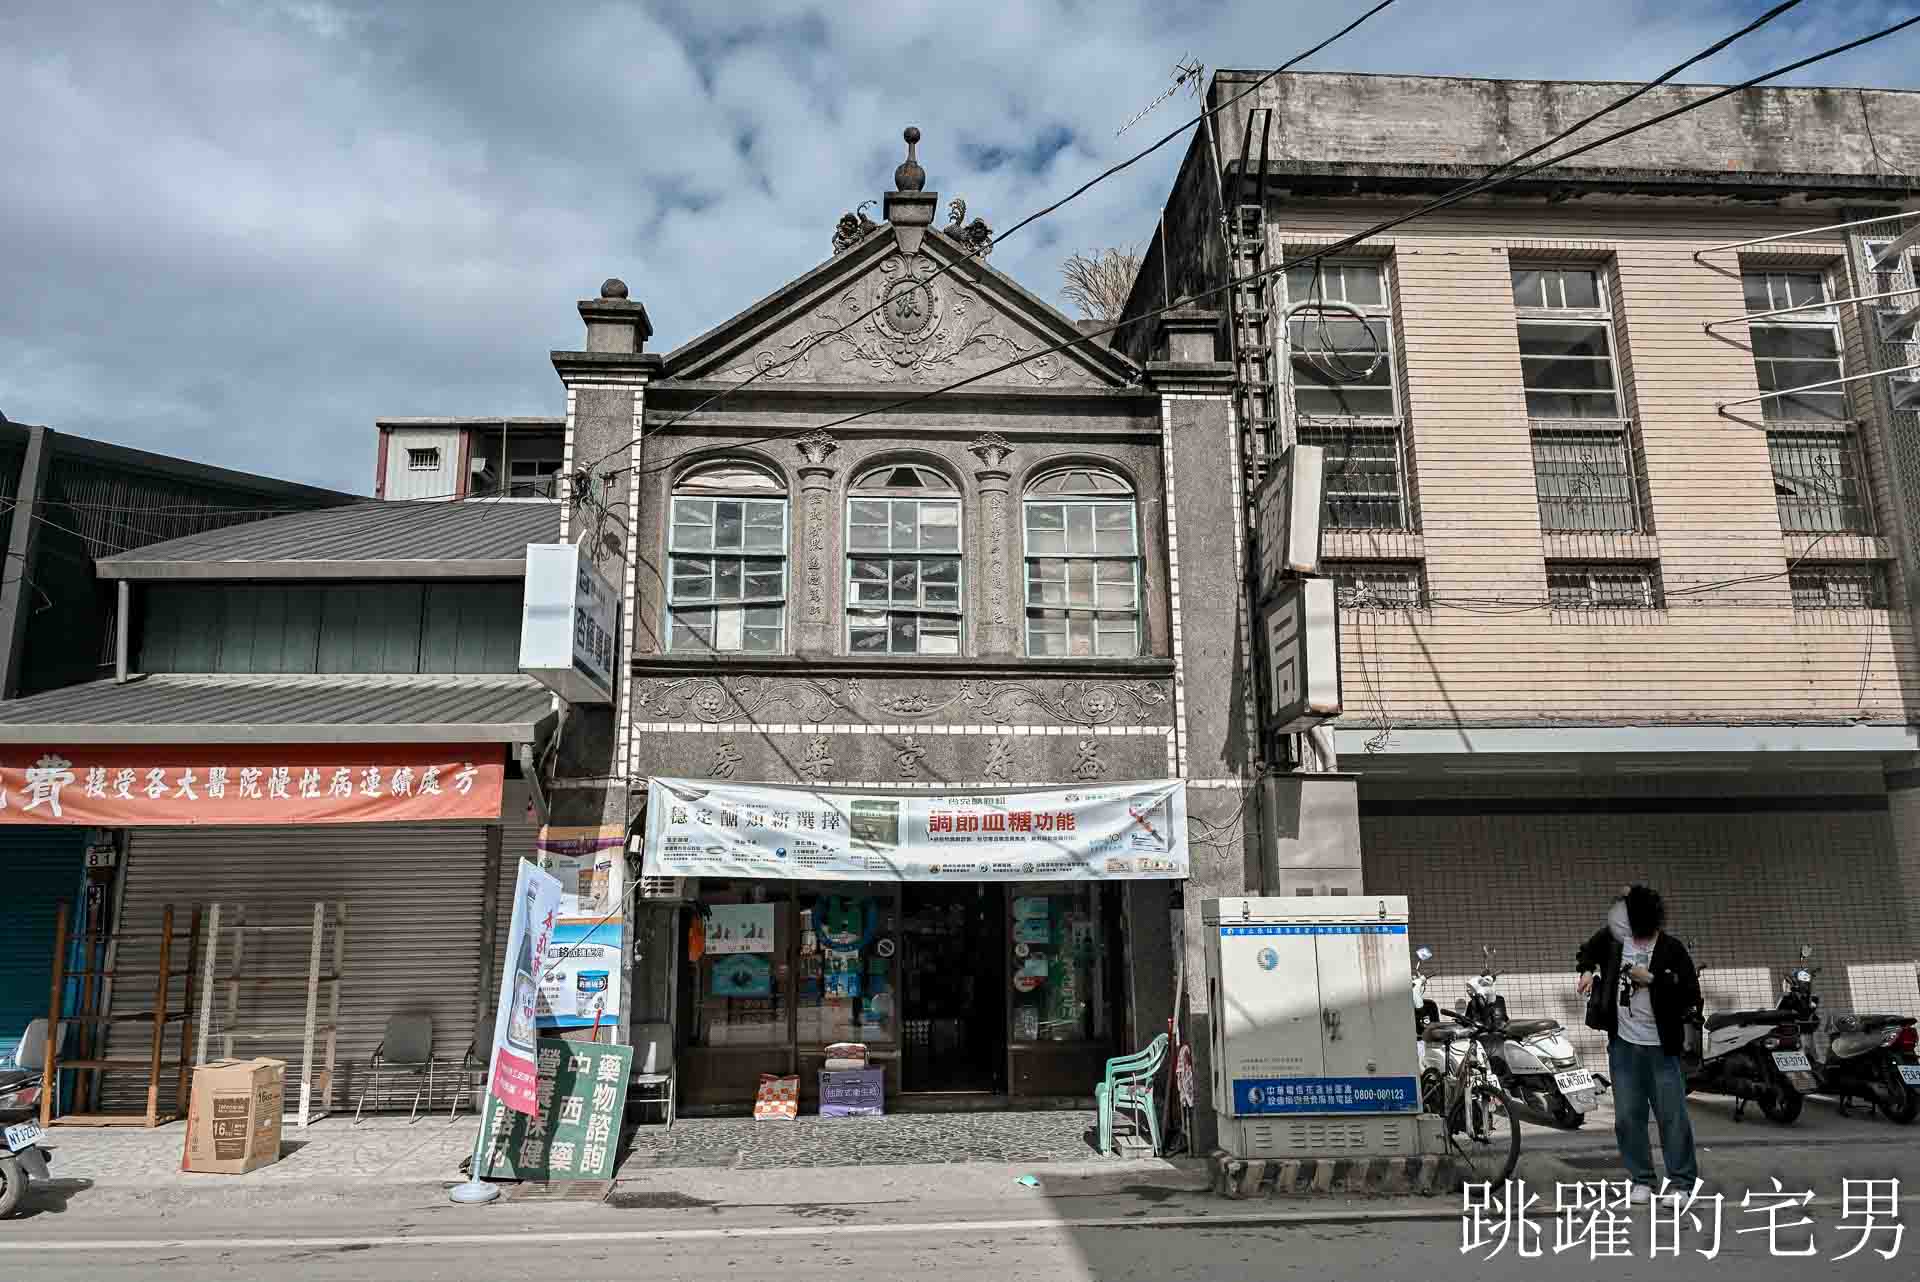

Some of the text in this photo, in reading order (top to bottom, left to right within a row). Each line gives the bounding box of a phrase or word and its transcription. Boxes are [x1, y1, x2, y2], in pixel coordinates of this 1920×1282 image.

[928, 809, 1076, 833] 調節血糖功能
[549, 1051, 592, 1172] 中西藥
[579, 1053, 622, 1174] 藥物諮詢
[1354, 1088, 1404, 1101] 0800-080123
